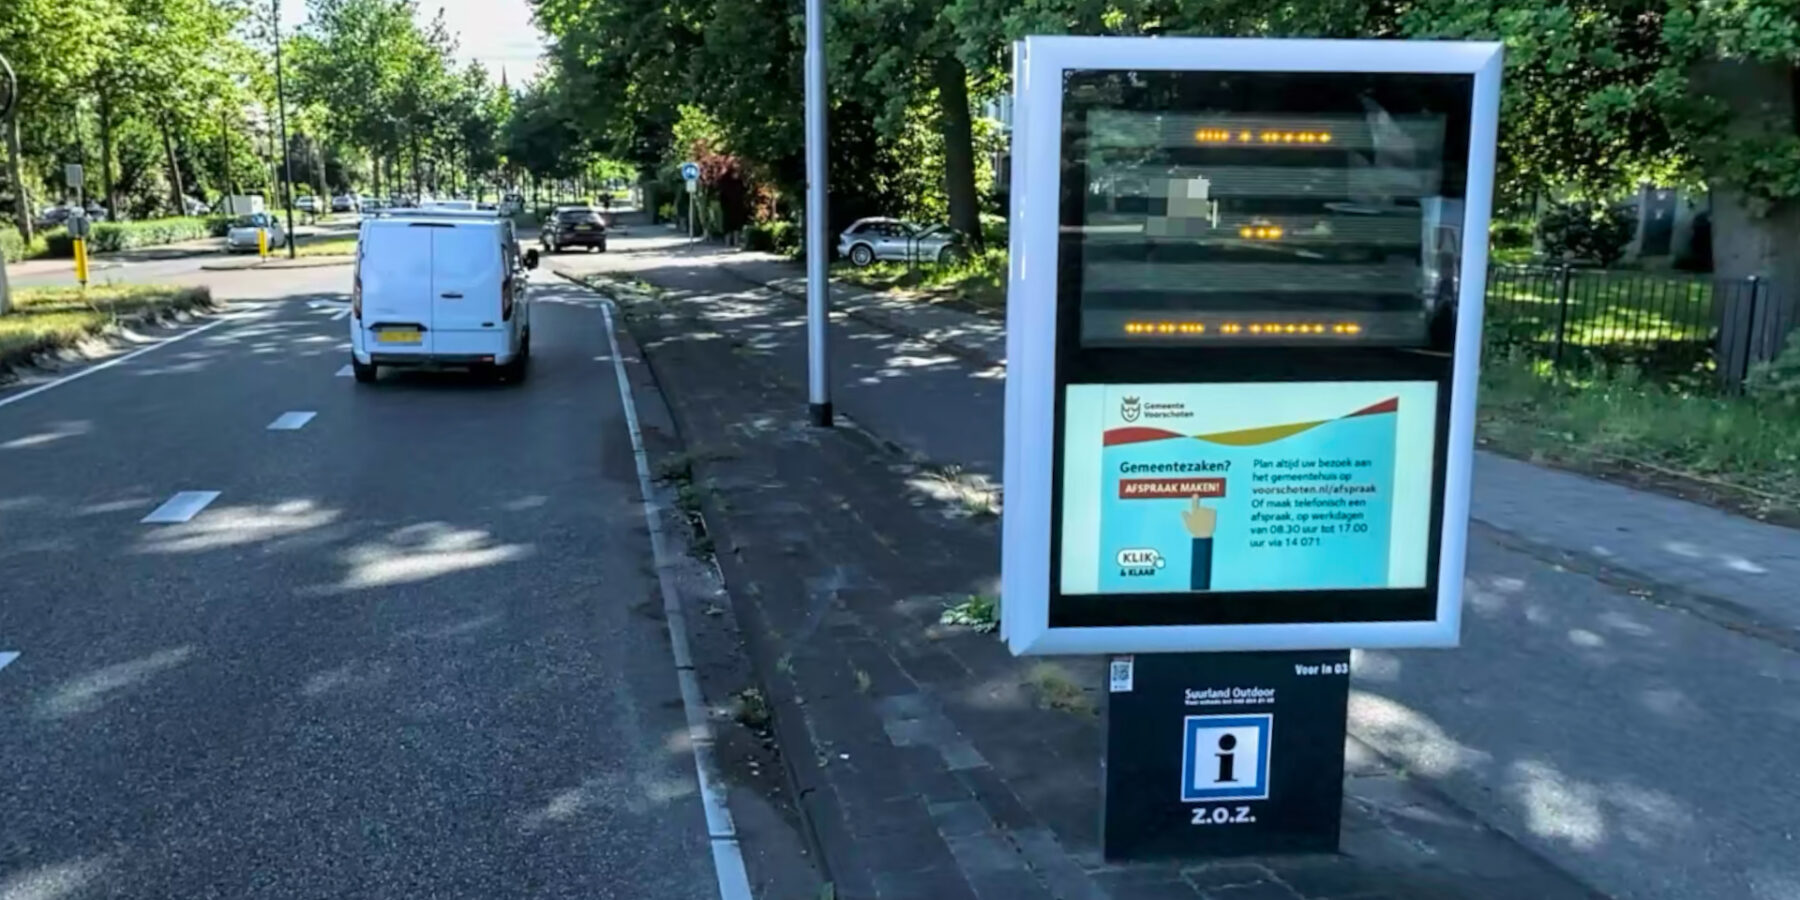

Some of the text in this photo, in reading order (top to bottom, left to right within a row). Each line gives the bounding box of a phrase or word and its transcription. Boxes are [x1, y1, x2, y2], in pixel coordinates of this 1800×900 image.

[1144, 402, 1185, 410] Gemeente
[1120, 460, 1231, 473] Gemeentezaken?
[1253, 459, 1273, 468] Plan
[1276, 459, 1299, 470] altijd
[1318, 458, 1352, 468] bezoek
[1253, 471, 1352, 484] het gemeentehuis op
[1125, 483, 1220, 493] AFSPRAAK MAKEN!
[1252, 483, 1376, 495] voorschoten.nl/afspraak
[1252, 497, 1366, 508] Of maak telefonisch een
[1251, 510, 1364, 522] afspraak, op werkdagen
[1269, 525, 1300, 534] 08.30
[1321, 524, 1335, 533] tot
[1249, 537, 1320, 547] uur via 14 071
[1123, 552, 1152, 563] KLIK
[1334, 662, 1348, 675] 03
[1184, 685, 1276, 699] Suurland Outdoor
